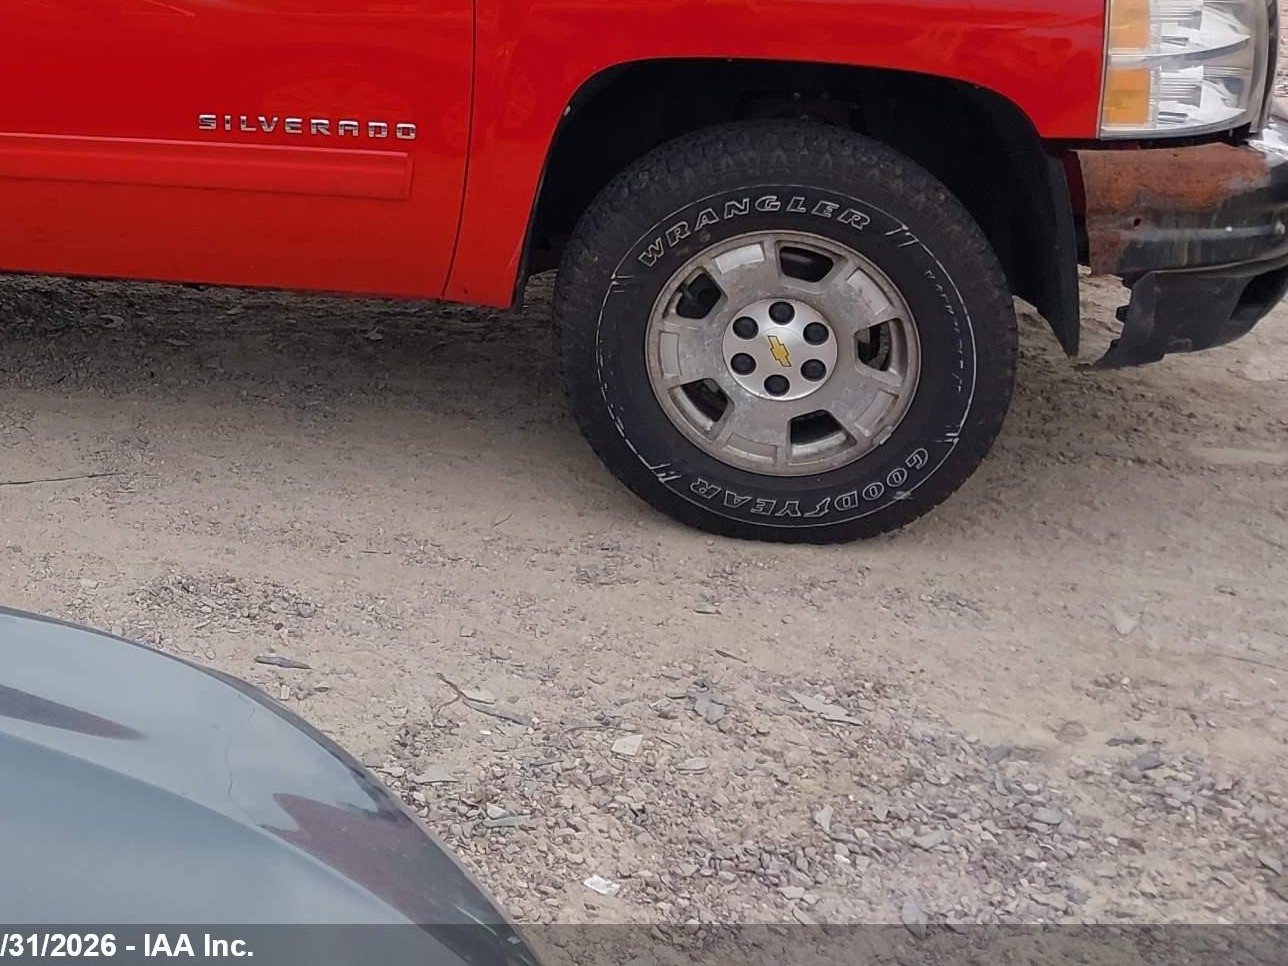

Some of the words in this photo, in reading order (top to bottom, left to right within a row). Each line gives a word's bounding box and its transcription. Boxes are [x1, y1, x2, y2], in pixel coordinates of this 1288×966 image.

[198, 114, 416, 140] SILVERADO
[637, 194, 871, 267] WRANGLER
[690, 447, 930, 519] GOODYEAR
